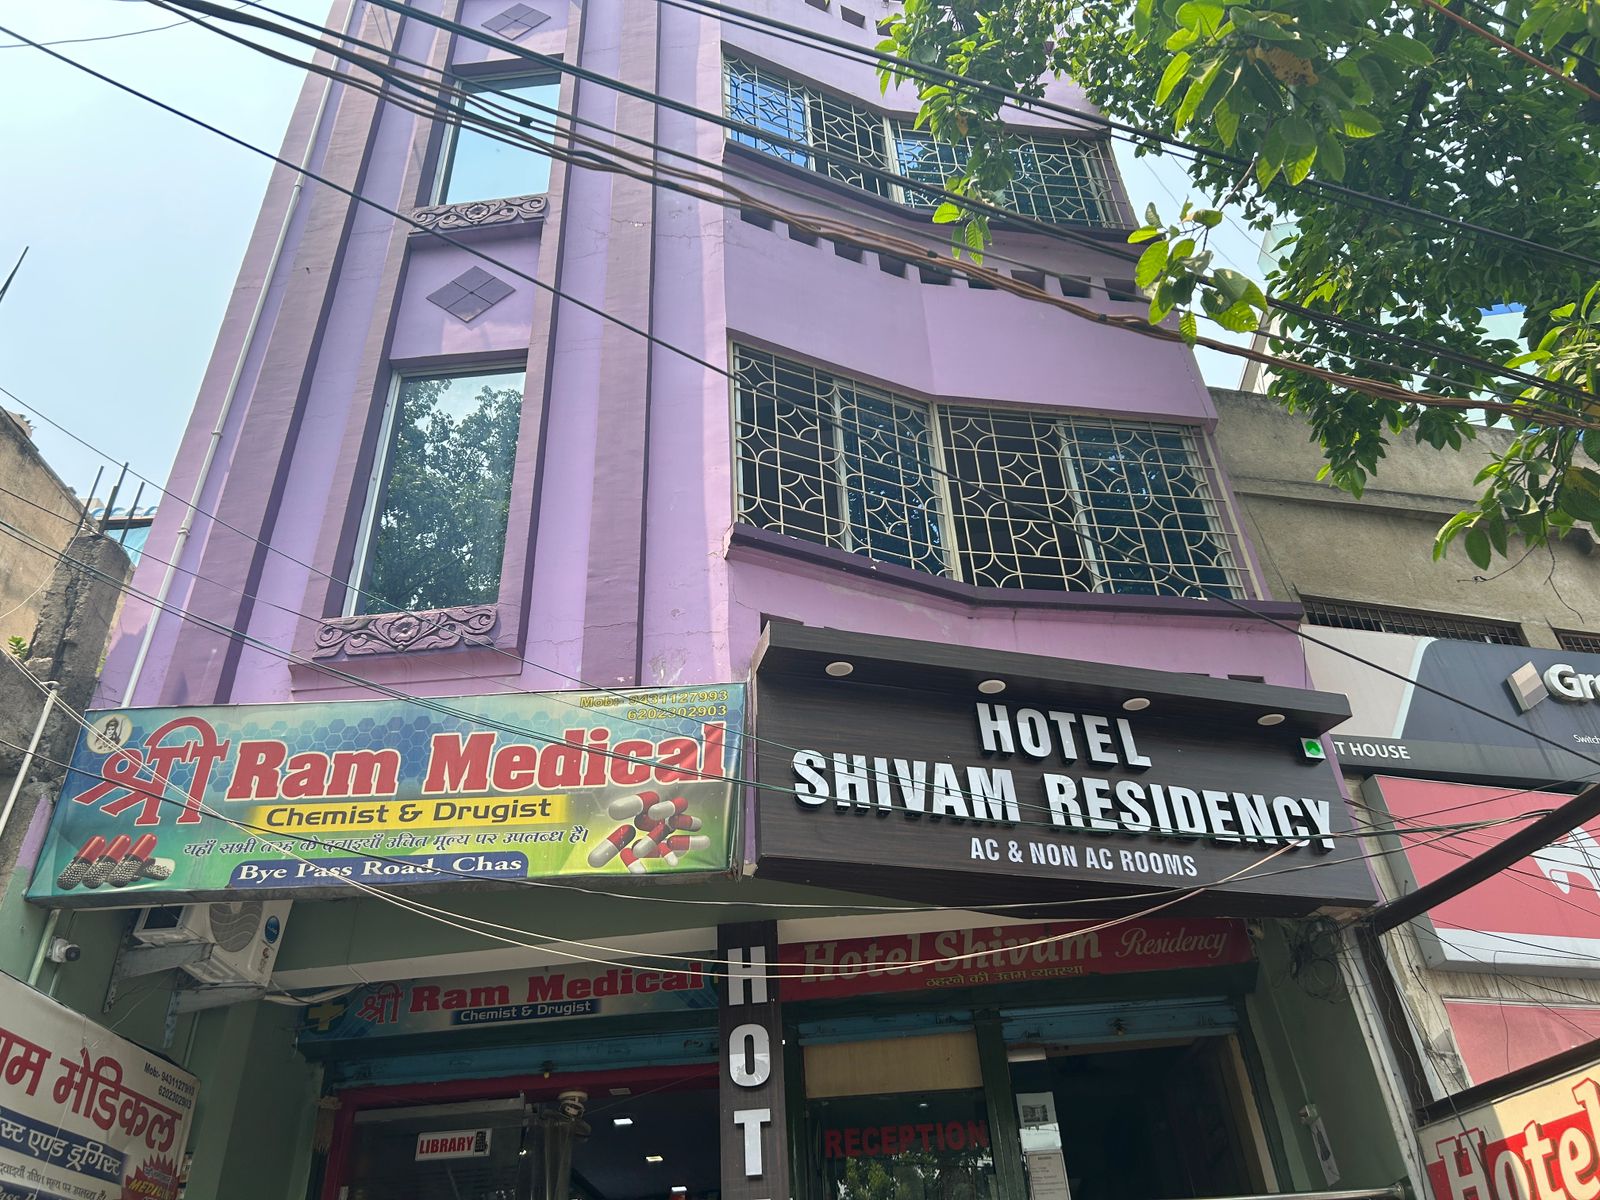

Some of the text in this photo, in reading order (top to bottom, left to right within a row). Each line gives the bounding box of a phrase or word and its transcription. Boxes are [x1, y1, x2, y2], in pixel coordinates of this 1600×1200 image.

[628, 690, 729, 705] 9431127993
[1543, 664, 1600, 702] Gr
[626, 705, 728, 720] 6202302903
[974, 701, 1152, 768] HOTEL
[1331, 741, 1411, 760] T HOUSE
[72, 715, 726, 826] श्री Ram Medical
[266, 798, 552, 827] Chemist & Drugist
[792, 748, 1336, 851] SHIVAM RESIDENCY
[219, 837, 257, 855] सभी
[260, 839, 295, 854] तरह
[386, 831, 428, 849] उचित
[432, 832, 470, 851] मूल्य
[475, 832, 498, 846] पर
[502, 829, 564, 845] उपलब्ध
[969, 837, 1198, 877] AC & NON AC ROOMS
[237, 864, 287, 884] Bye
[296, 861, 353, 877] Pass
[452, 855, 522, 873] Chas
[800, 927, 1229, 983] Hotel Shivam Residency
[356, 962, 703, 1024] श्री Ram Medical
[970, 971, 989, 985] की
[460, 1001, 591, 1022] Chemist & Drugist
[728, 945, 771, 1200] HOT
[53, 1047, 182, 1153] मेडिकल
[419, 1135, 475, 1155] LIBRARY
[824, 1120, 989, 1159] RECEPTION
